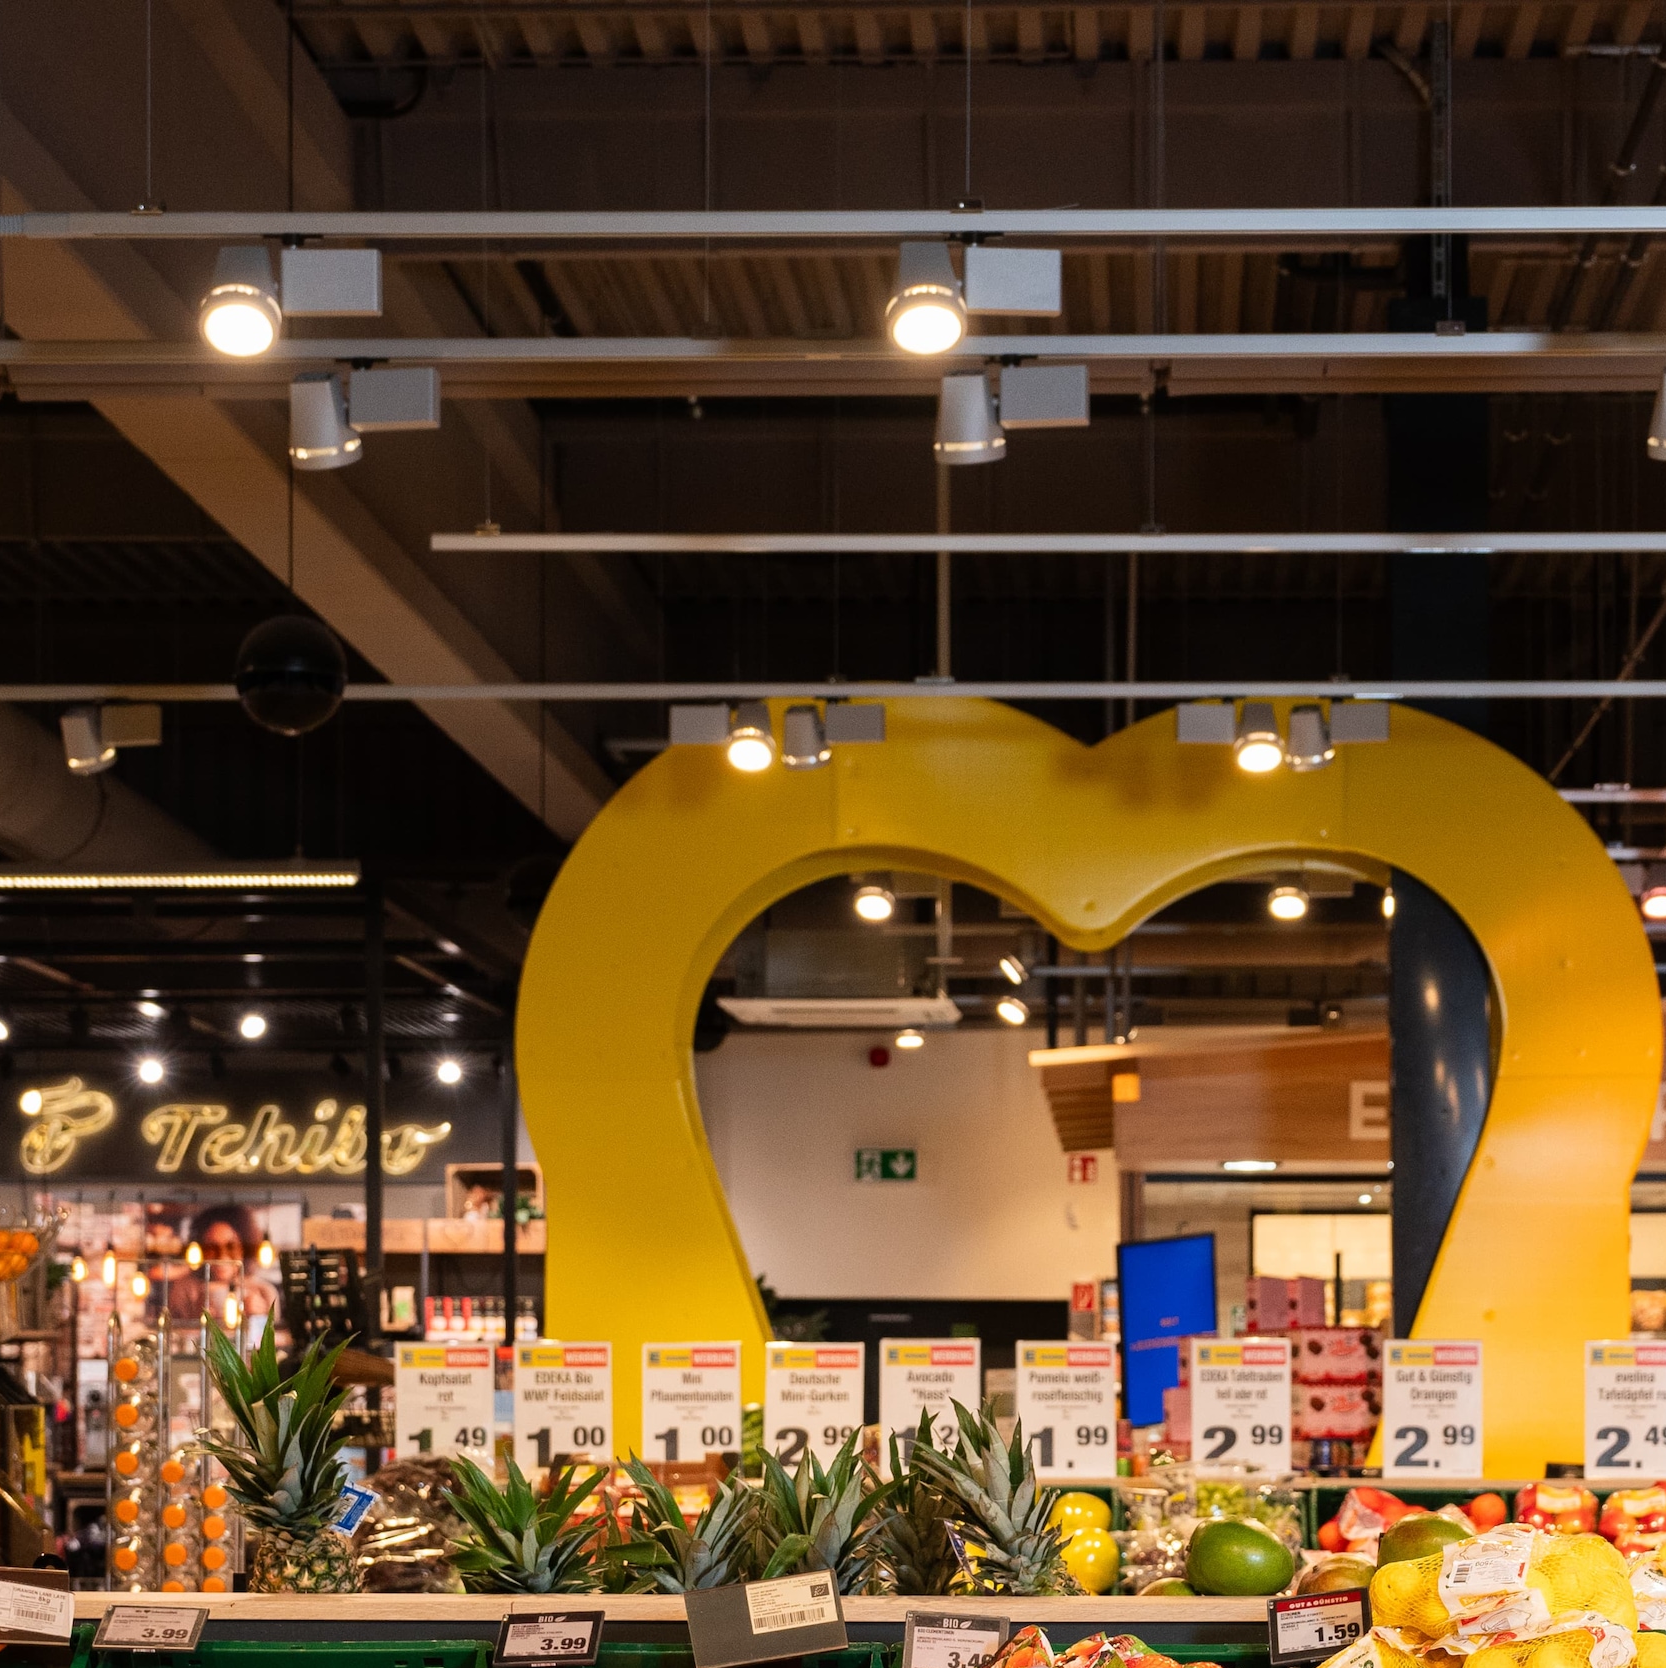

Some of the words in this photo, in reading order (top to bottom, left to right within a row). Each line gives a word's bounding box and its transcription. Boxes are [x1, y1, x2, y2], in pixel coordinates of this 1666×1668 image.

[141, 1098, 452, 1175] Tchibo
[419, 1372, 471, 1386] Kopfsalat
[534, 1373, 572, 1384] EDEKA
[575, 1373, 593, 1384] Bio
[682, 1372, 702, 1384] Mini
[789, 1373, 841, 1385] Deutsche
[907, 1371, 954, 1384] Avocado
[1029, 1372, 1070, 1384] Pomelo
[1075, 1372, 1105, 1385] weiß-
[1615, 1370, 1655, 1383] evelina
[438, 1390, 453, 1402] rot
[523, 1390, 551, 1401] WWF
[554, 1390, 604, 1402] Feldsalat
[651, 1390, 733, 1402] Pflaumentomaten
[781, 1390, 849, 1402] Mini-Gurken
[912, 1388, 950, 1401] "Hass"
[1032, 1389, 1103, 1403] roséfleischig
[1410, 1387, 1457, 1402] Orangen
[455, 1426, 488, 1447] 49
[539, 1615, 554, 1623] BIO
[942, 1619, 958, 1628] BIO
[141, 1628, 188, 1639] 3.99
[1315, 1622, 1361, 1643] 1.59
[541, 1637, 587, 1652] 3.99
